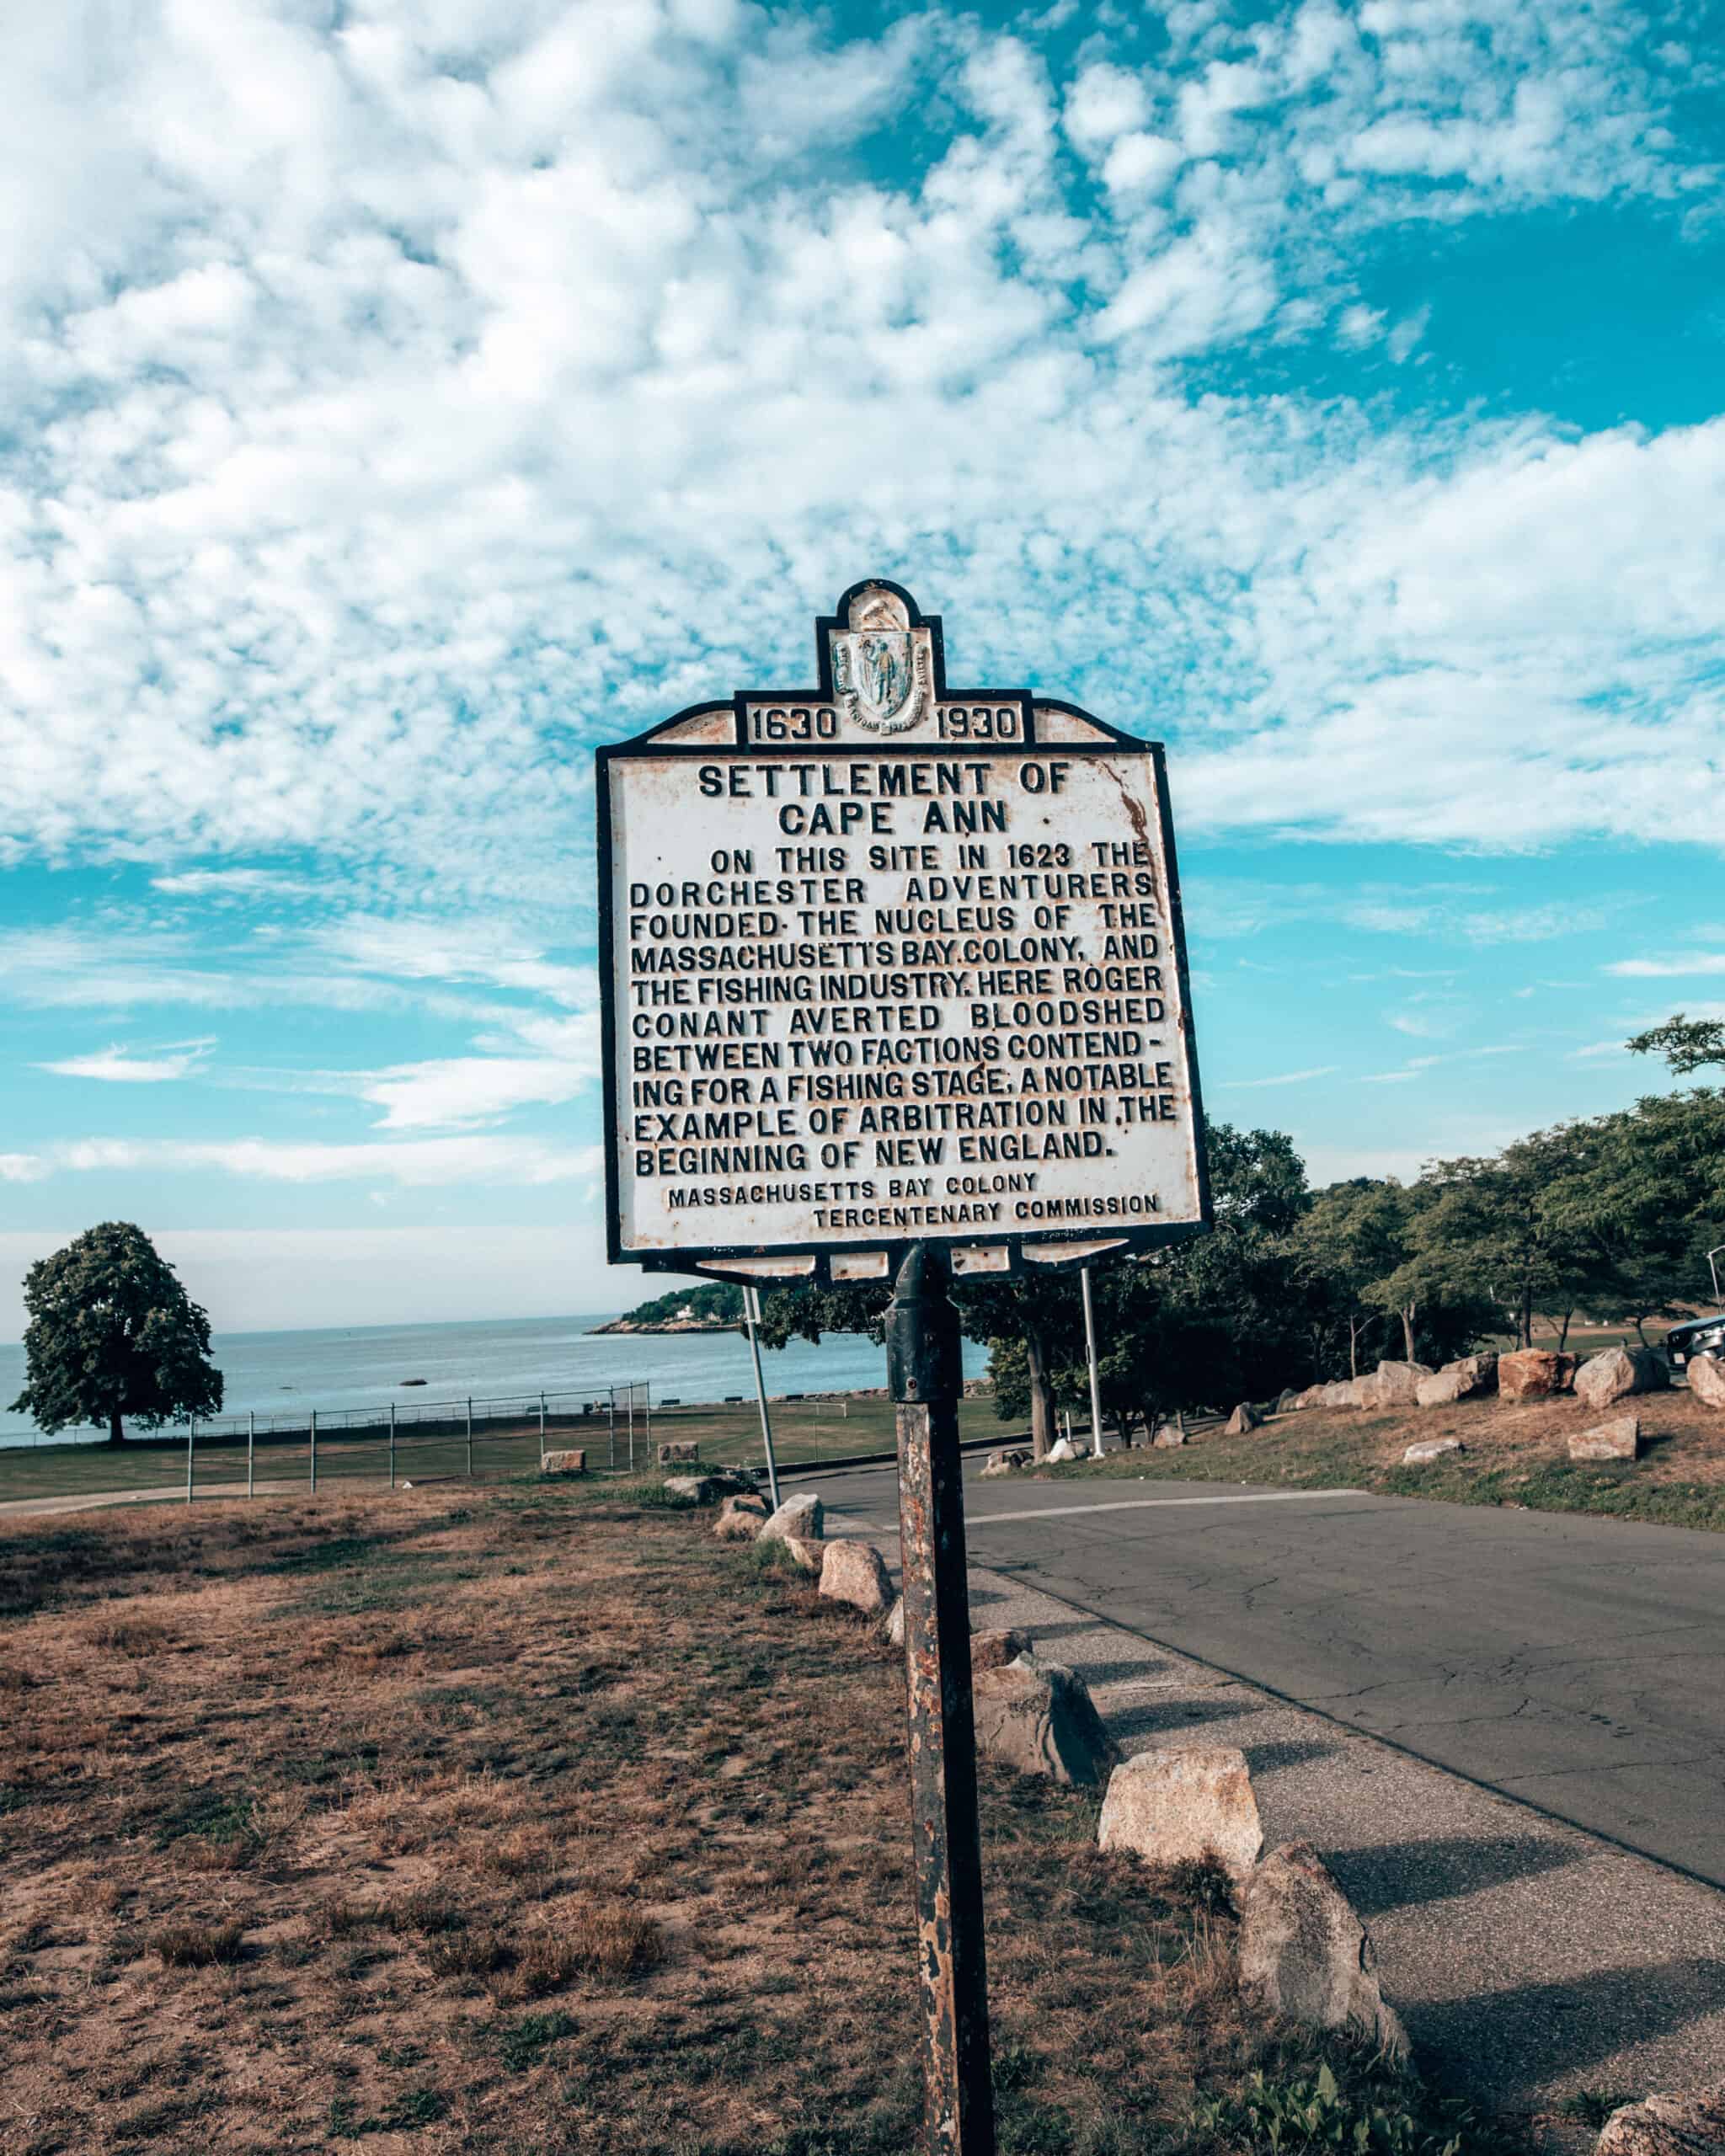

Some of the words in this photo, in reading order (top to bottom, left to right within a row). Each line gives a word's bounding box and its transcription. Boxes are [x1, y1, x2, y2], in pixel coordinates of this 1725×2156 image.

[754, 708, 836, 739] 1630
[937, 707, 1016, 738] 1930
[699, 764, 991, 797] SETTLEMENT
[1021, 763, 1068, 793] OF
[780, 803, 892, 835] CAPE
[924, 801, 1006, 833] ANN
[712, 851, 750, 873] ON
[776, 847, 845, 872] THIS
[869, 846, 937, 870] SITE
[959, 846, 985, 869] IN
[1008, 844, 1070, 867] 1623
[1092, 842, 1149, 867] THE
[631, 879, 863, 907] DORCHESTER
[907, 873, 1151, 901] ADVENTURERS
[798, 910, 857, 935] THE
[876, 907, 1013, 934] NUCLEUS
[1035, 905, 1070, 930] OF
[1099, 904, 1155, 928] THE
[633, 942, 893, 972] MASSACHUSETTS
[903, 940, 955, 965] BAY
[964, 937, 1083, 963] COLONY,
[1104, 935, 1157, 959] AND
[632, 979, 690, 1006] THE
[698, 976, 811, 1003] FISHING
[979, 969, 1051, 995] HERE
[1064, 966, 1162, 992] ROGER
[633, 1010, 767, 1038] CONANT
[791, 1006, 939, 1033] AVERTED
[972, 998, 1164, 1028] BLOODSHED
[634, 1043, 778, 1071] BETWEEN
[788, 1040, 852, 1066] TWO
[862, 1036, 999, 1065] FACTIONS
[633, 1080, 682, 1107] ING
[692, 1079, 750, 1105] FOR
[761, 1077, 778, 1102] A
[788, 1072, 903, 1101] FISHING
[912, 1069, 1012, 1096] STAGE,
[1022, 1068, 1038, 1092] A
[1045, 1062, 1172, 1091] NOTABLE
[635, 1110, 795, 1141] EXAMPLE
[809, 1108, 847, 1134] OF
[860, 1100, 1065, 1132] ARBITRATION
[1080, 1097, 1106, 1123] IN
[1119, 1095, 1175, 1122] THE
[637, 1144, 805, 1176] BEGINNING
[822, 1142, 859, 1168] OF
[876, 1138, 943, 1166] NEW
[959, 1132, 1112, 1161] ENGLAND.
[670, 1182, 873, 1207] MASSACHUSETTS
[889, 1179, 927, 1197] BAY
[947, 1173, 1035, 1194] COLONY
[814, 1203, 999, 1227] TERCENTENARY
[1016, 1195, 1157, 1219] COMMISSION
